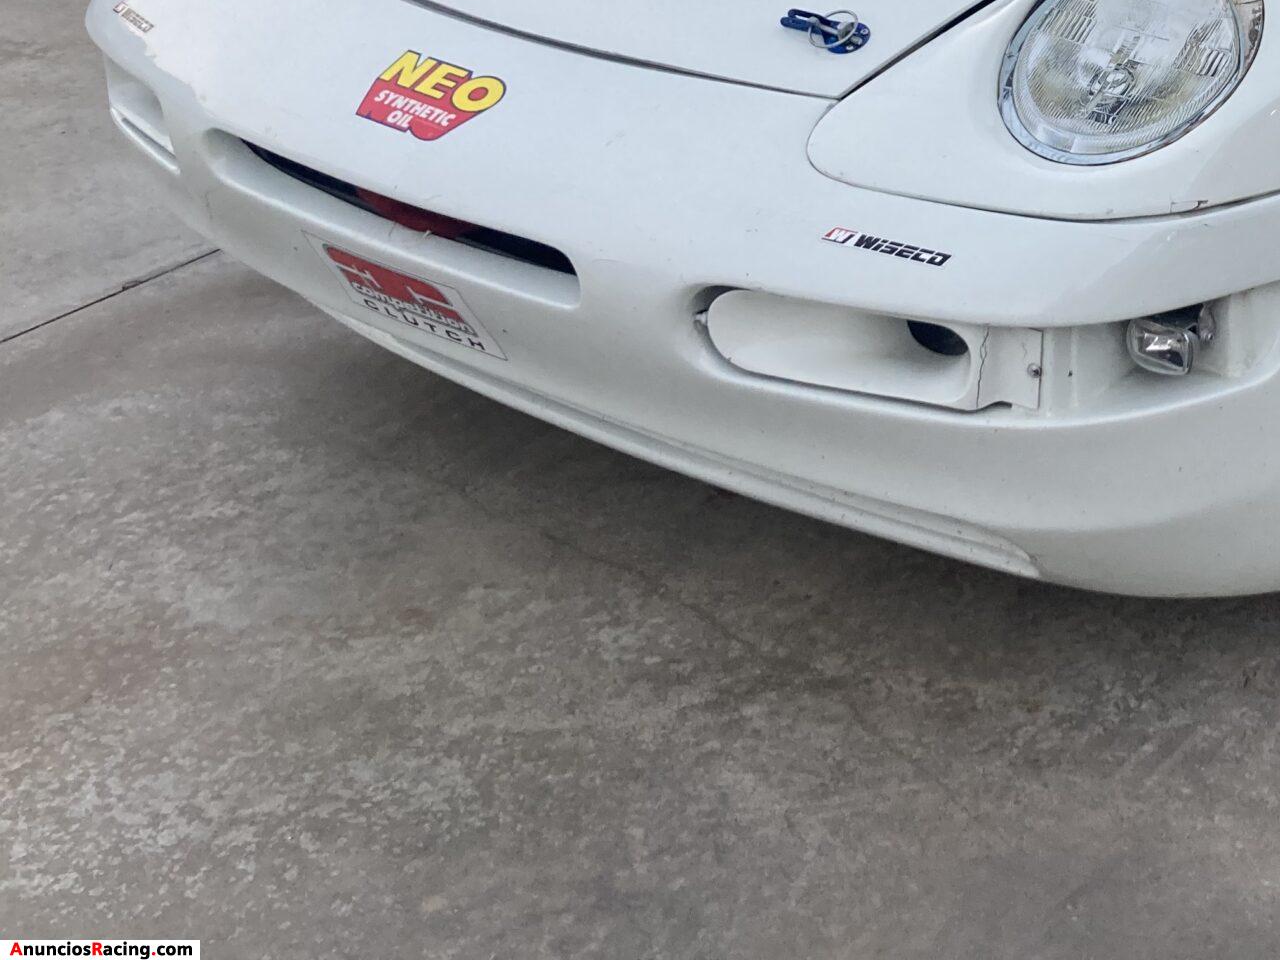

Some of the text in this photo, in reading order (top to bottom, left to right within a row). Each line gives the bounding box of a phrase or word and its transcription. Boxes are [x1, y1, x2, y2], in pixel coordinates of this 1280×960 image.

[379, 50, 506, 112] NEO
[374, 90, 457, 127] SYNTHETIC
[386, 110, 415, 128] OIL
[363, 298, 485, 351] CLUTCH
